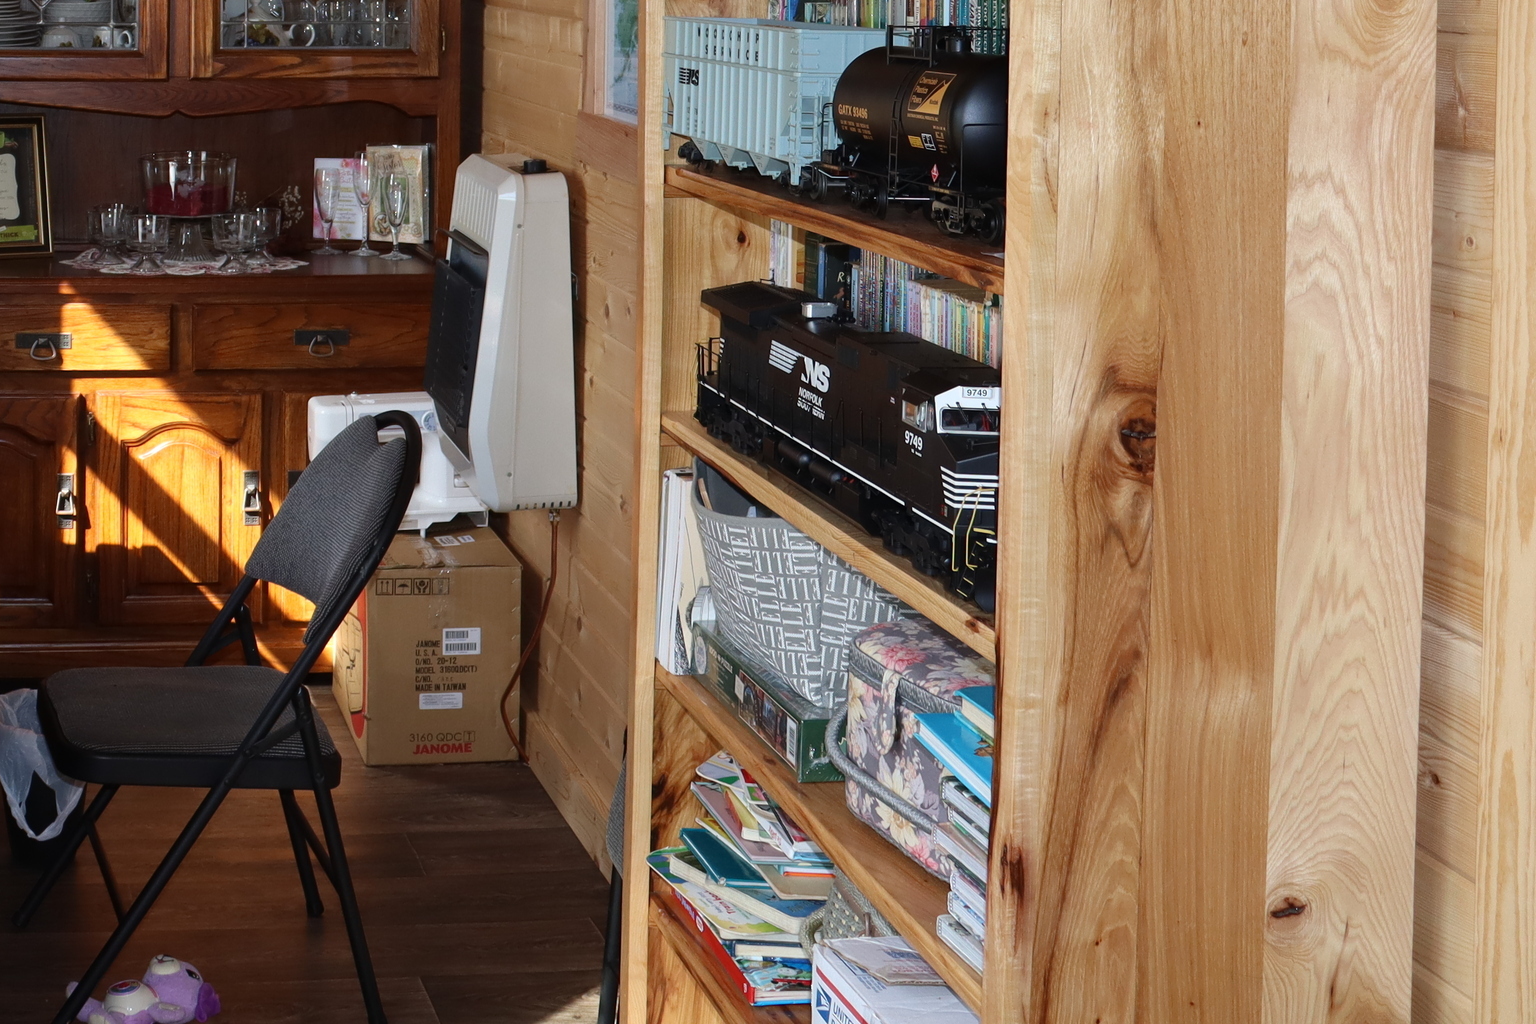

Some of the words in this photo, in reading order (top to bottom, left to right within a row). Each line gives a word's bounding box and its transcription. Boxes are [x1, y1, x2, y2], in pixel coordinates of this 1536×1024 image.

[838, 104, 852, 116] GATX
[852, 106, 869, 119] 93496
[798, 386, 823, 407] NORFOLK
[904, 430, 923, 450] 9749
[416, 640, 441, 648] JANOME
[437, 657, 457, 665] 20-12
[415, 666, 435, 674] MODEL
[415, 683, 433, 692] MADE
[442, 683, 466, 691] TAIWAN
[409, 733, 434, 743] 3160
[435, 732, 464, 743] QDC
[413, 742, 473, 755] JANOME
